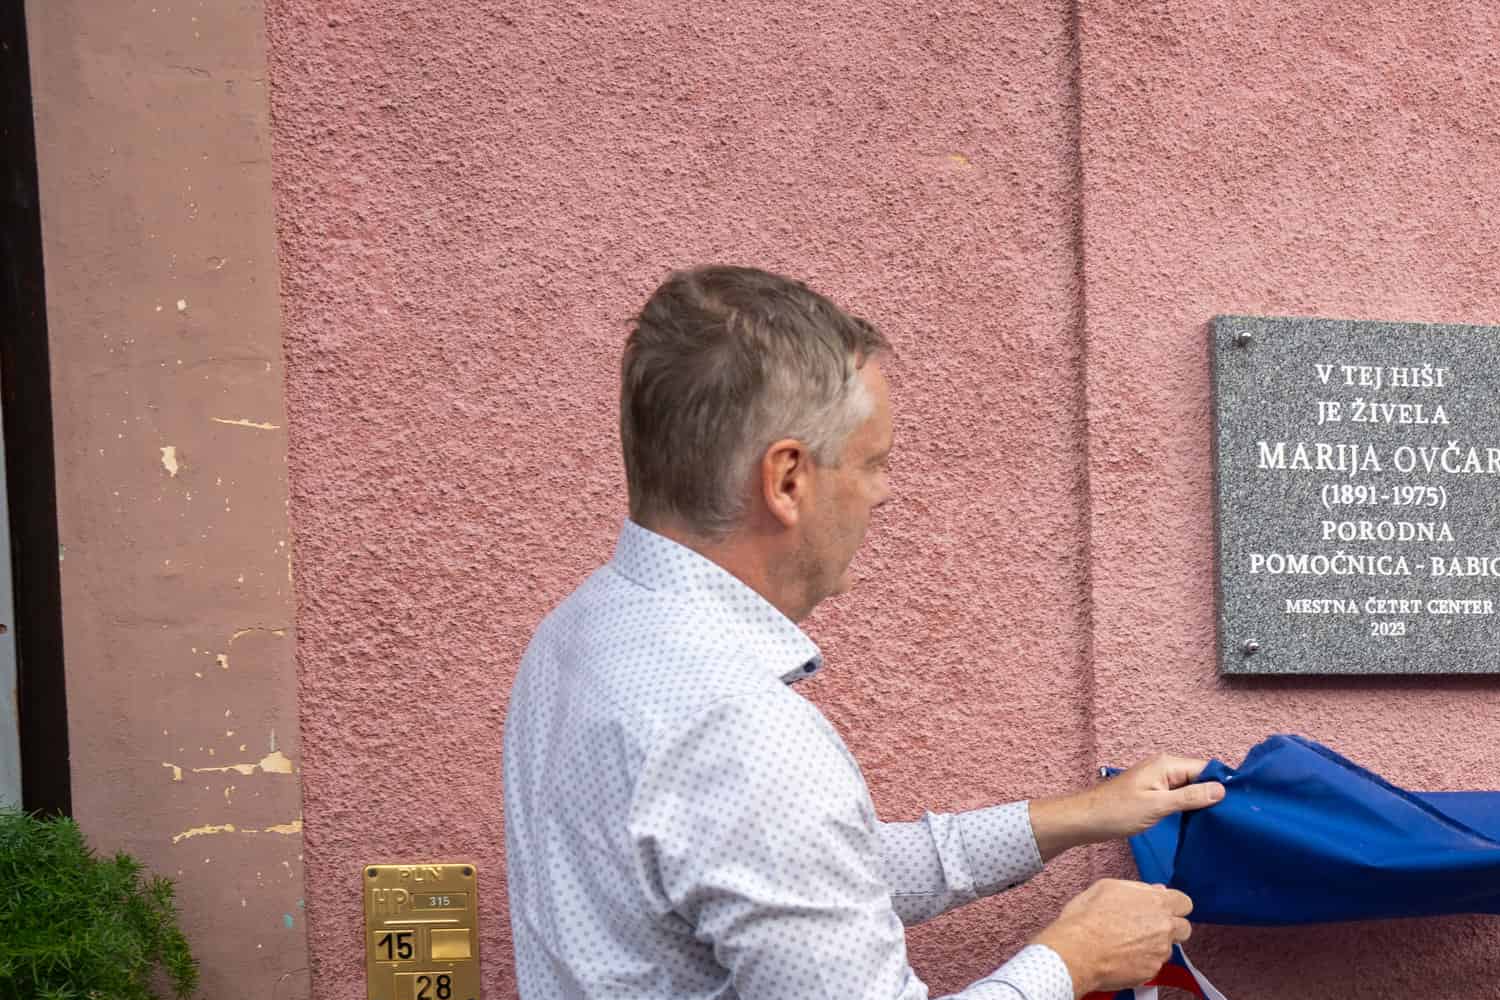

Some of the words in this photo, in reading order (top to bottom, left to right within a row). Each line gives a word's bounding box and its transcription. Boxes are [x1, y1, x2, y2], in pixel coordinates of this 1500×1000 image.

[1315, 365, 1333, 384] V
[1342, 366, 1382, 390] TEJ
[1391, 363, 1446, 387] HIŠI
[1318, 402, 1341, 425] JE
[1352, 398, 1450, 425] ŽIVELA
[1257, 441, 1382, 476] MARIJA
[1322, 521, 1454, 542] PORODNA
[1250, 551, 1411, 576] POMOČNICA
[1286, 600, 1358, 613] MESTNA
[1365, 597, 1421, 613] ČETRT
[1427, 600, 1494, 614] CENTER
[1371, 622, 1405, 636] 2023
[378, 933, 412, 959] 15
[416, 975, 451, 1000] 28
